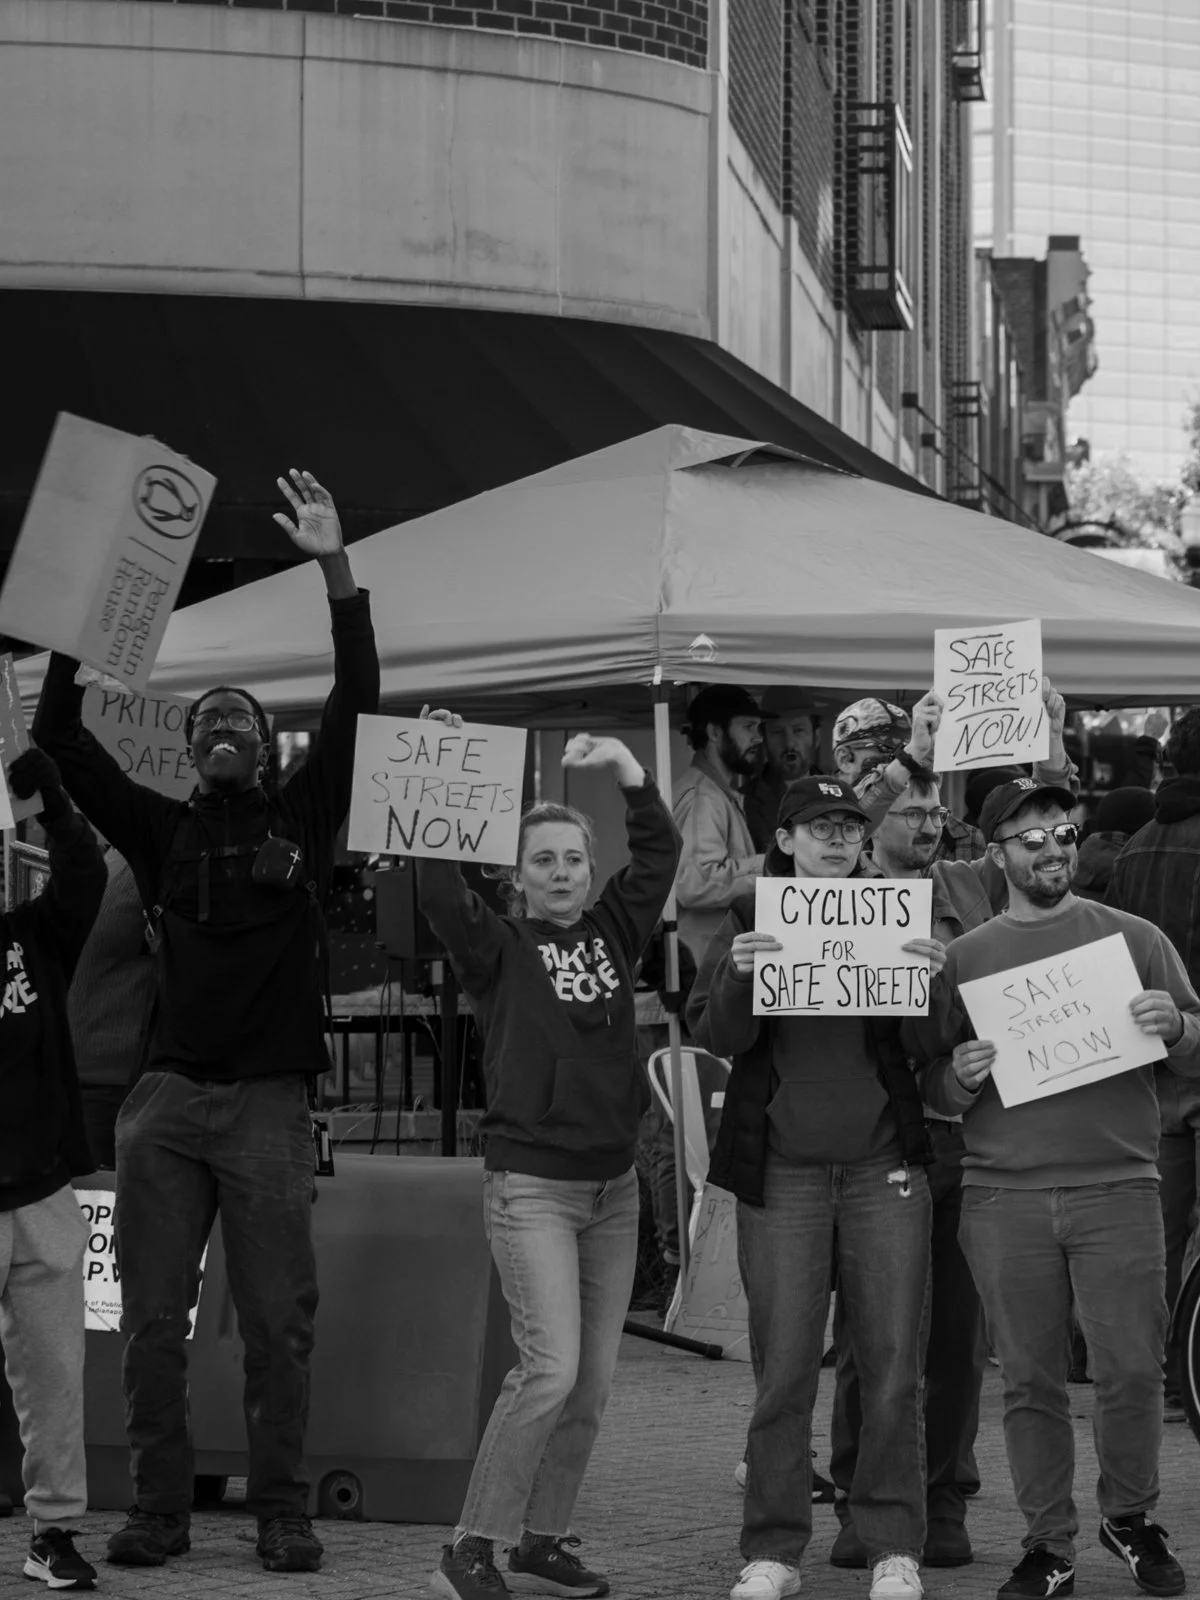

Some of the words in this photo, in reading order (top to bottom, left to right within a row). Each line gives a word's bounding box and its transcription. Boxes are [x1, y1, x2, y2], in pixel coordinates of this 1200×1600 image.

[100, 557, 136, 632] House
[106, 567, 153, 666] Random
[125, 576, 170, 676] Penguin
[949, 638, 1017, 673] SAFE
[101, 689, 190, 732] PRITO
[948, 669, 1038, 711] STREETS
[387, 730, 488, 774] SAFE
[953, 707, 1043, 757] NOW!
[371, 772, 515, 813] STREETS
[386, 806, 488, 852] NOW
[781, 885, 910, 927] CYCLISTS
[822, 939, 856, 961] FOR
[760, 963, 824, 1008] SAFE
[837, 965, 929, 1009] STREETS
[1002, 962, 1083, 1019] SAFE
[1008, 1001, 1092, 1039] STREETS
[1027, 1027, 1113, 1072] NOW
